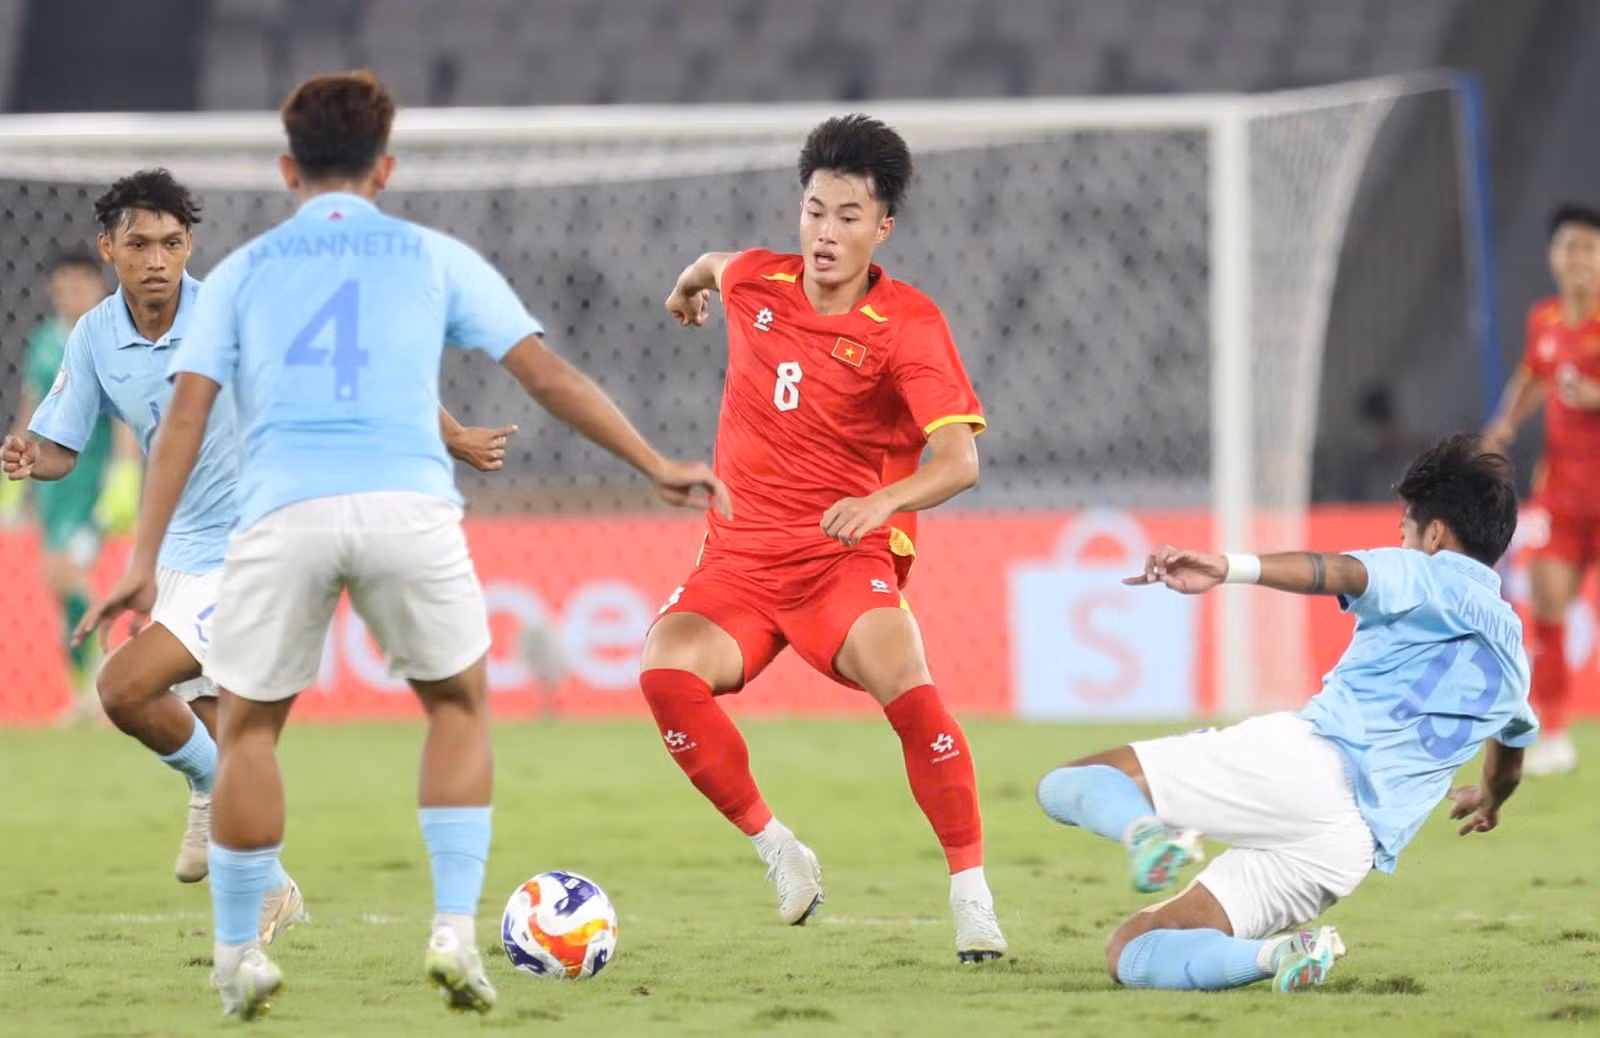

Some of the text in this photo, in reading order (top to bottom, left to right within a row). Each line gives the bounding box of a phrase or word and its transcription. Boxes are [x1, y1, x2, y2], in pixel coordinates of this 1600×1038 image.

[283, 279, 369, 401] 4
[773, 361, 803, 412] 8
[1070, 587, 1143, 705] S
[1389, 640, 1504, 760] 13
